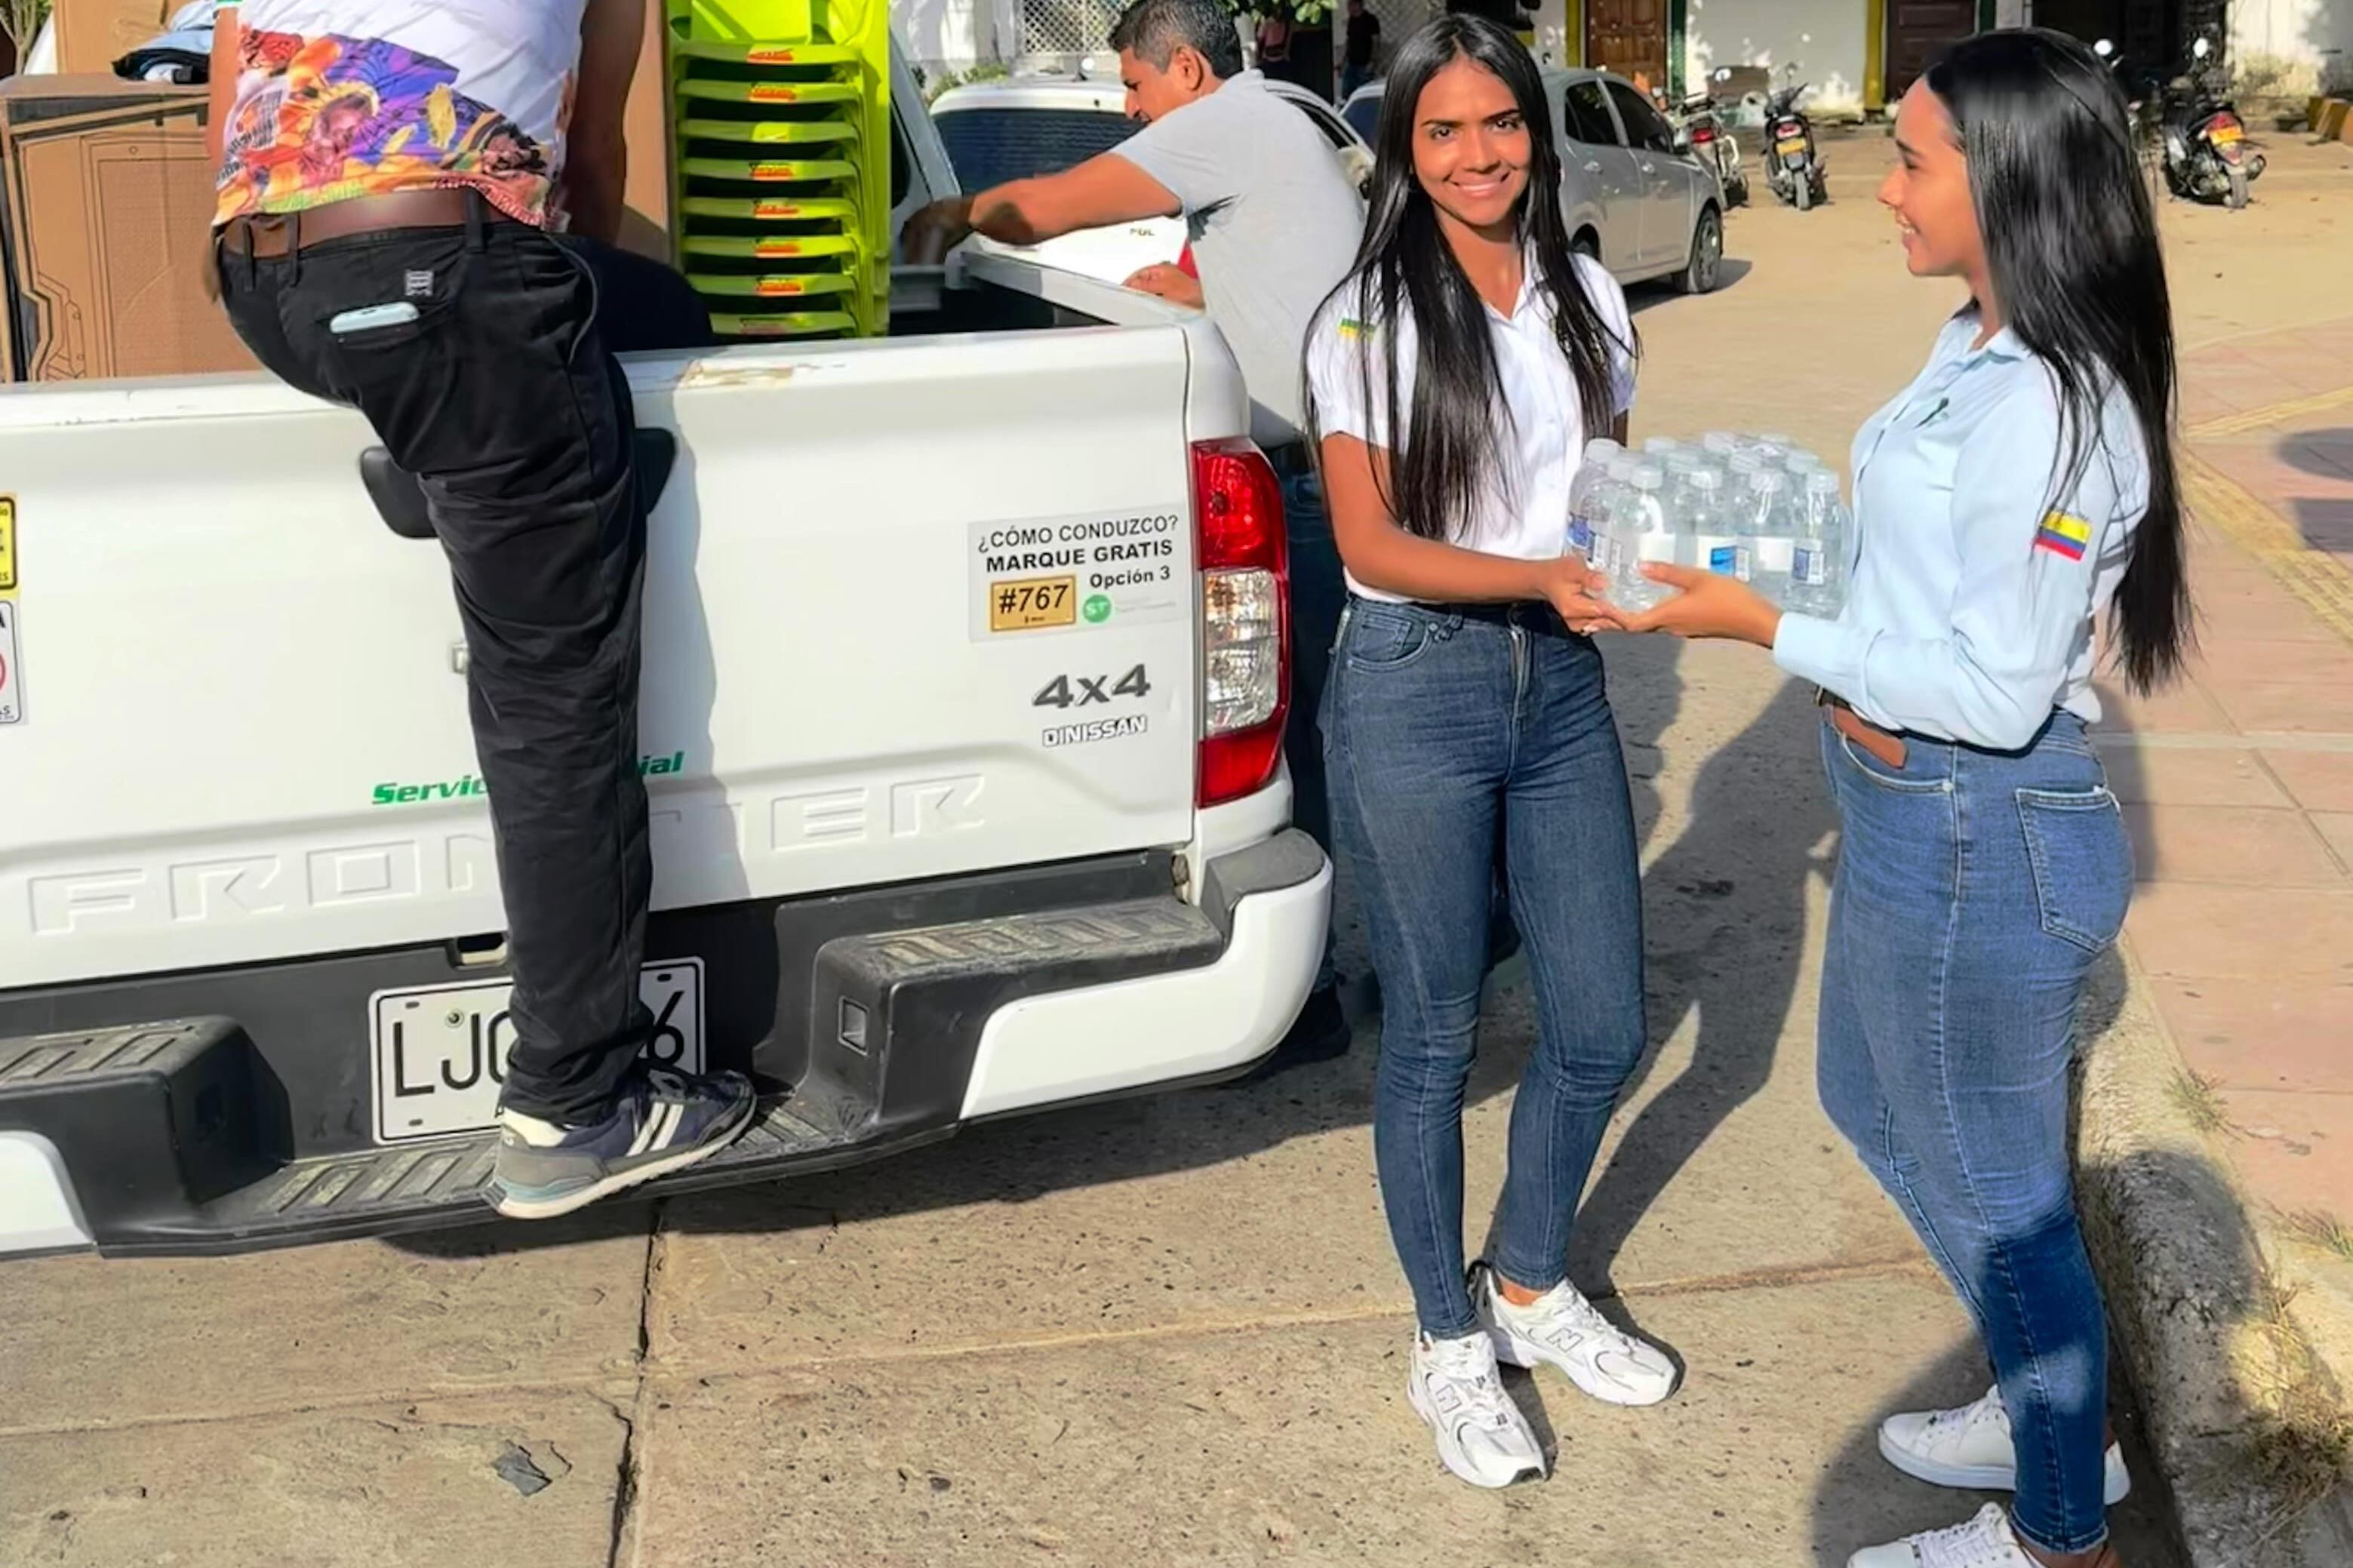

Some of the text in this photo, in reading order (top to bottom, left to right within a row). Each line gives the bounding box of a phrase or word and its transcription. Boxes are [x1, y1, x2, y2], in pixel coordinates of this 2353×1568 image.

[978, 515, 1178, 553] ¿CÓMO CONDUZCO?
[986, 539, 1173, 573] MARQUE GRATIS
[1090, 565, 1170, 589] Opción 3
[998, 584, 1069, 614] #767
[1042, 715, 1148, 747] DINISSAN
